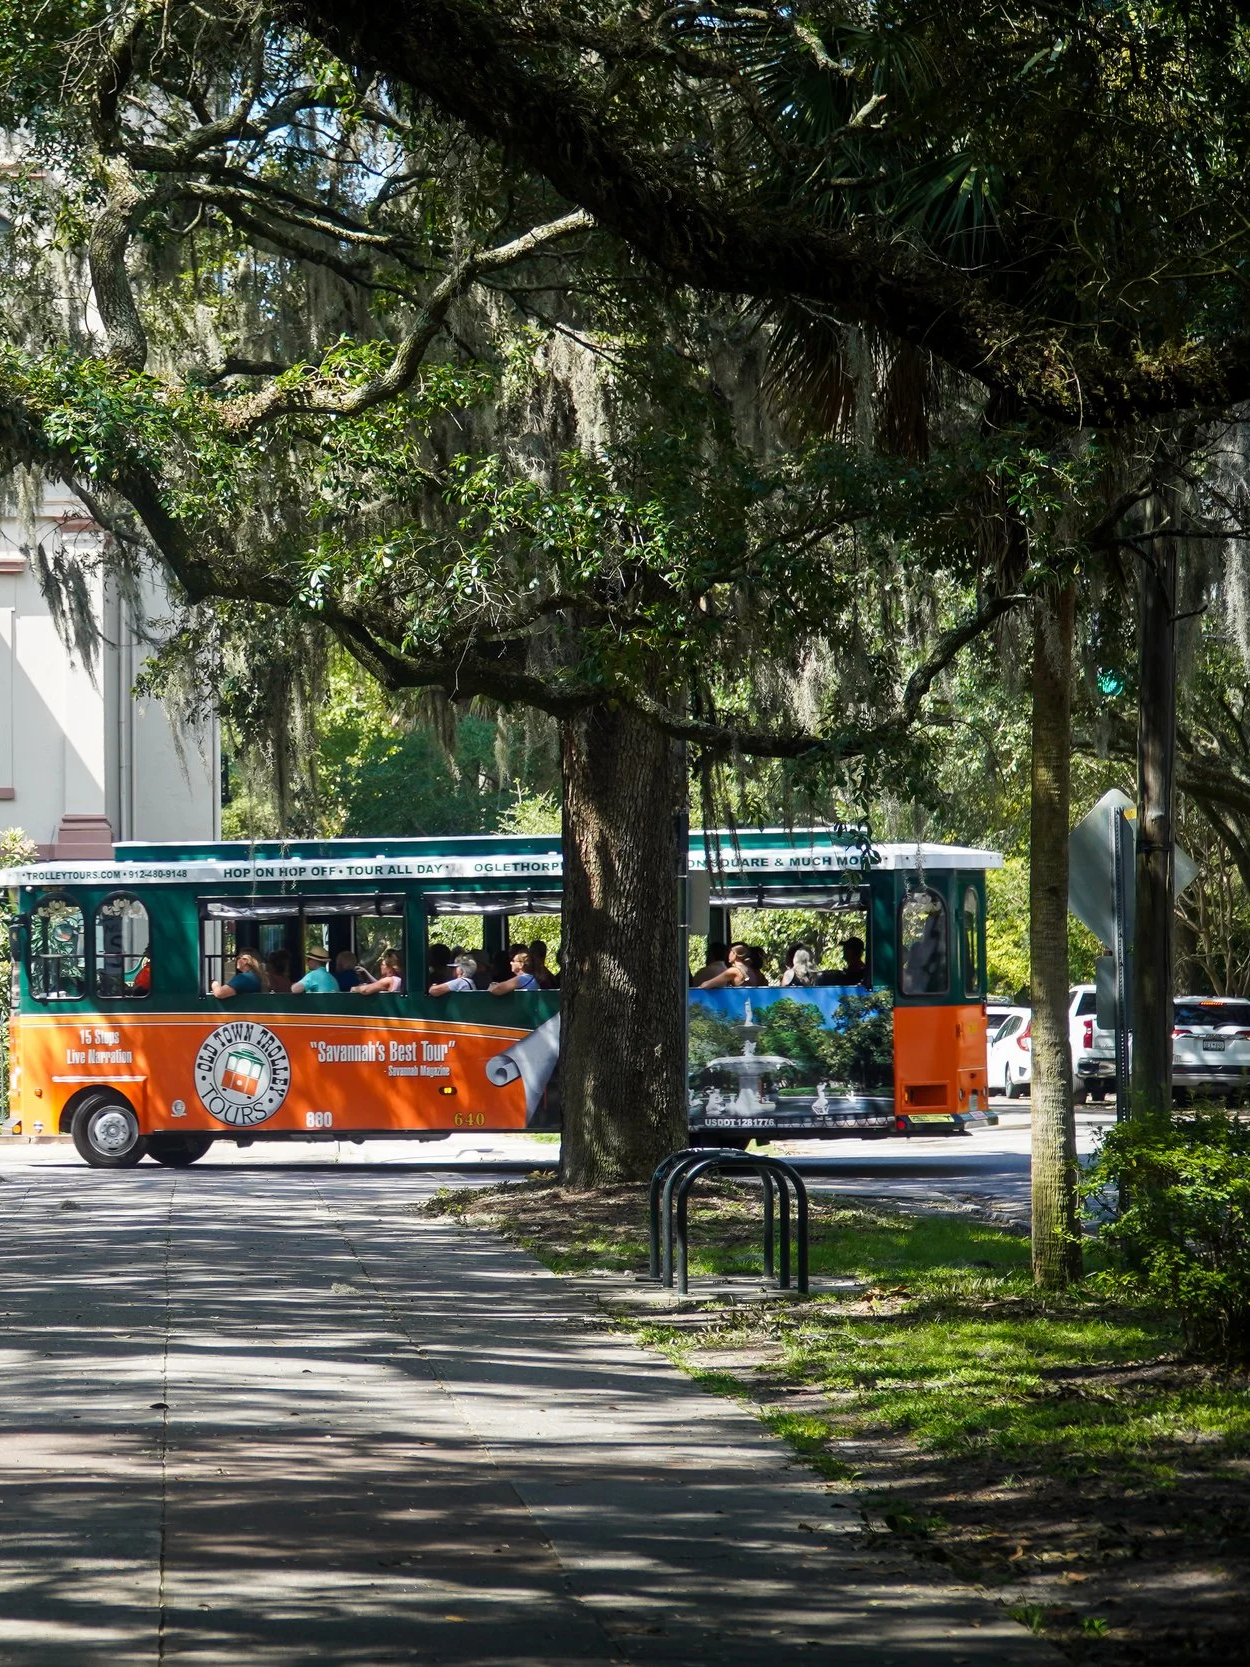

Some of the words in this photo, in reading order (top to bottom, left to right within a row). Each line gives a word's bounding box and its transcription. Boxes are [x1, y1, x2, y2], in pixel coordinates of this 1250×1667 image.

[774, 857, 784, 867] &
[789, 856, 832, 866] MUCH
[27, 871, 121, 880] TROLLEYTOURS.COM
[129, 869, 187, 879] 912-480-9148
[224, 868, 250, 878] HOP
[255, 867, 274, 877] ON
[279, 866, 306, 877] HOP
[311, 866, 336, 876] OFF
[347, 865, 383, 875] TOUR
[388, 864, 412, 874] ALL
[417, 864, 442, 874] DAY
[79, 1029, 92, 1044] 15
[94, 1029, 120, 1046] Stops
[66, 1049, 86, 1064] Live
[88, 1049, 132, 1064] Narration
[389, 1040, 417, 1062] Best
[197, 1043, 218, 1072] OLD
[213, 1023, 254, 1048] TOWN
[256, 1029, 288, 1097] TROLLEY
[388, 1065, 419, 1076] Savannah
[420, 1065, 450, 1078] Magazine
[201, 1083, 268, 1124] TOURS
[454, 1112, 485, 1126] 640
[704, 1118, 736, 1127] USDOT
[737, 1118, 775, 1127] 1281776
